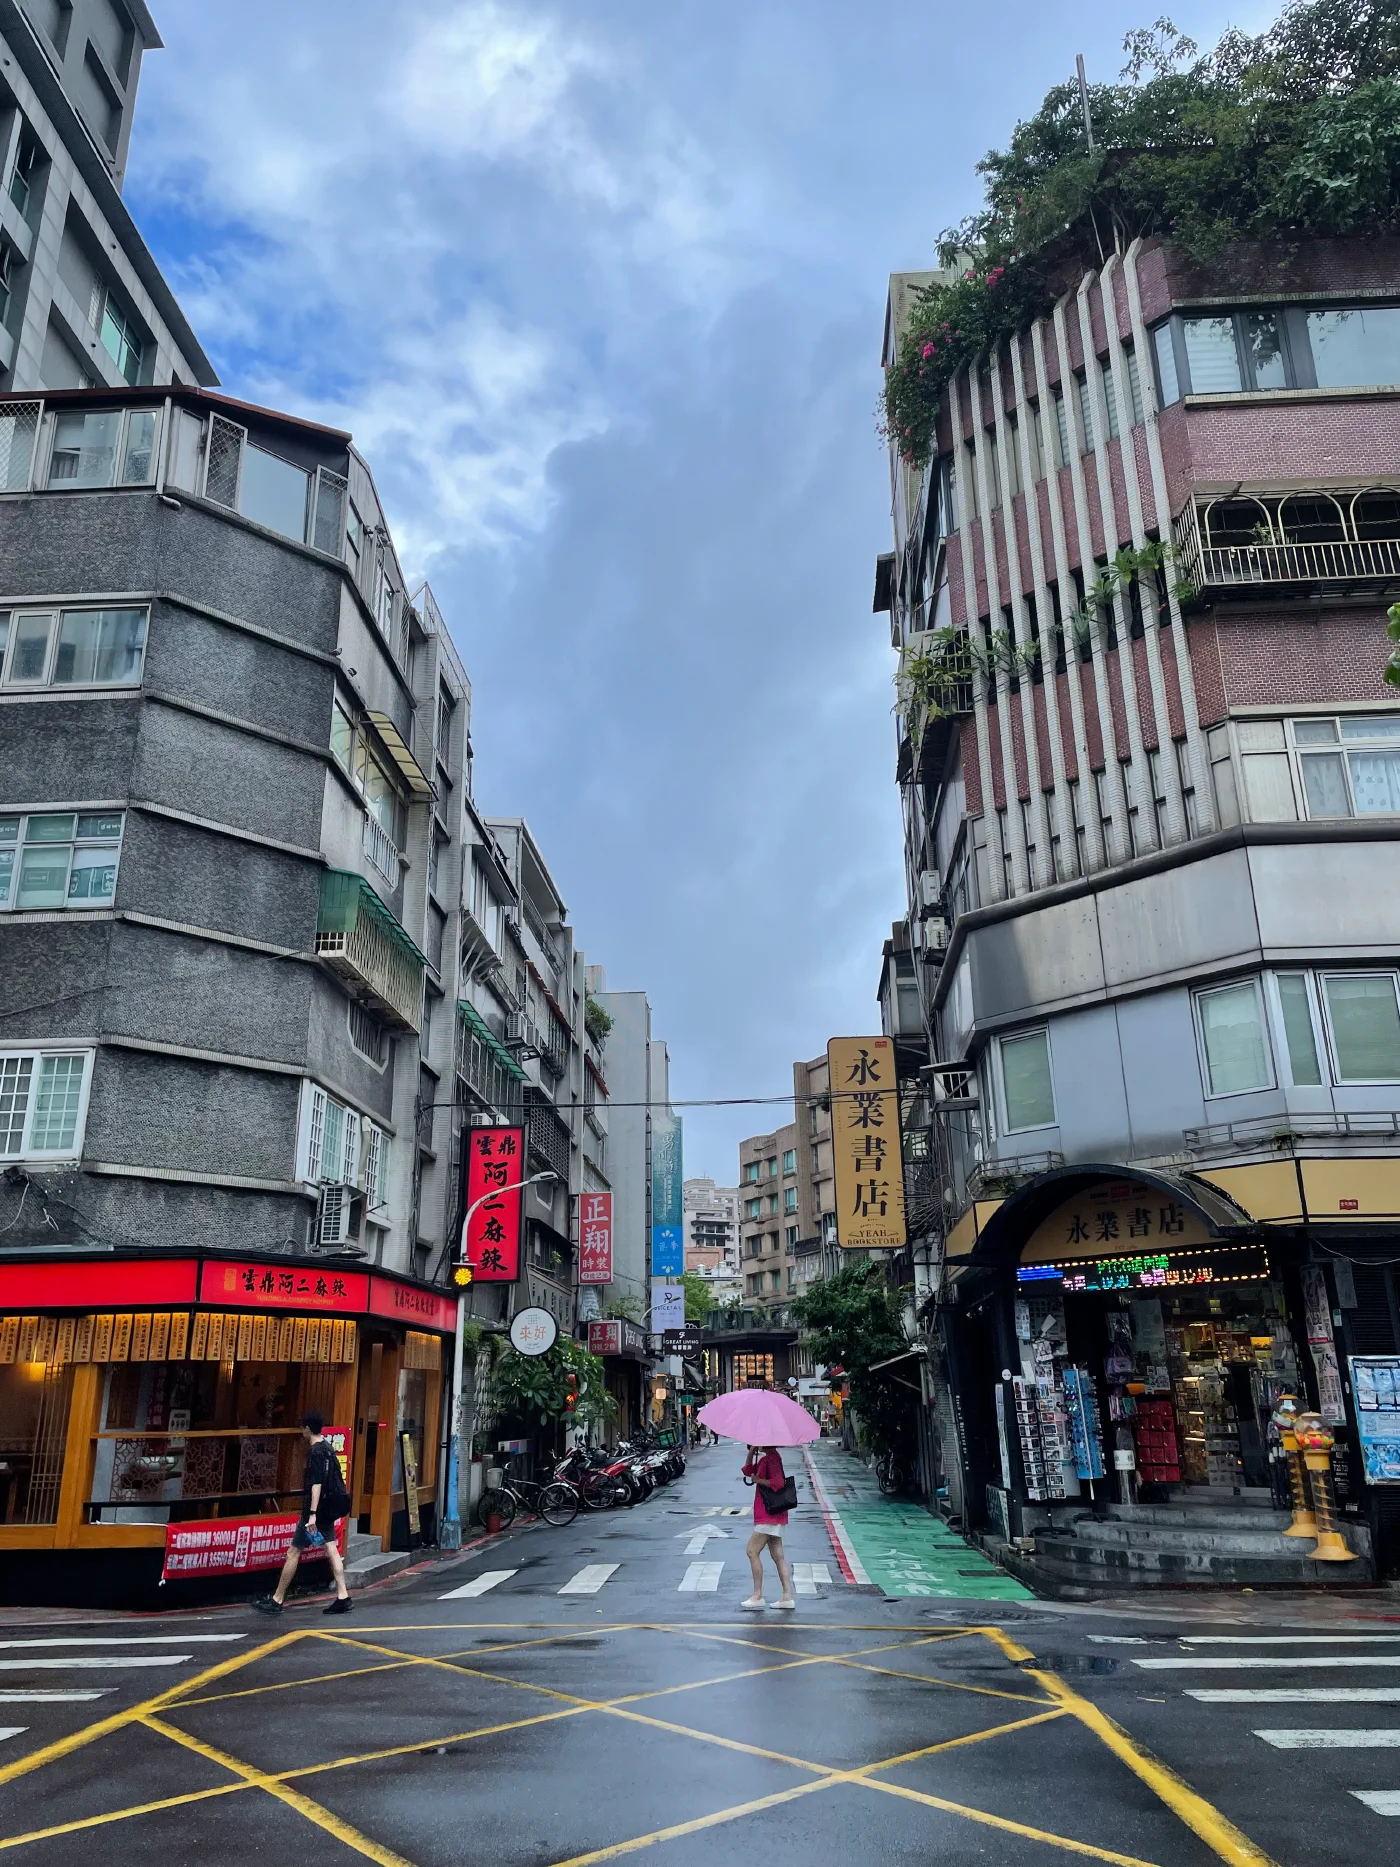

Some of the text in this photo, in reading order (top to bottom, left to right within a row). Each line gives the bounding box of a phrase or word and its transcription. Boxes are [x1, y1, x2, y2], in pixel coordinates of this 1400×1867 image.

[476, 1135, 516, 1156] 雲鼎
[844, 1049, 889, 1218] 永業書店
[478, 1162, 508, 1273] 阿二麻辣
[583, 1196, 609, 1255] 正翔
[1066, 1204, 1185, 1244] 永業書店
[847, 1237, 902, 1245] BOOKSTORE
[582, 1257, 609, 1270] 時裝
[242, 1269, 347, 1297] 雲鼎阿二麻辣
[520, 1325, 547, 1341] 來好
[592, 1324, 617, 1341] 正翔
